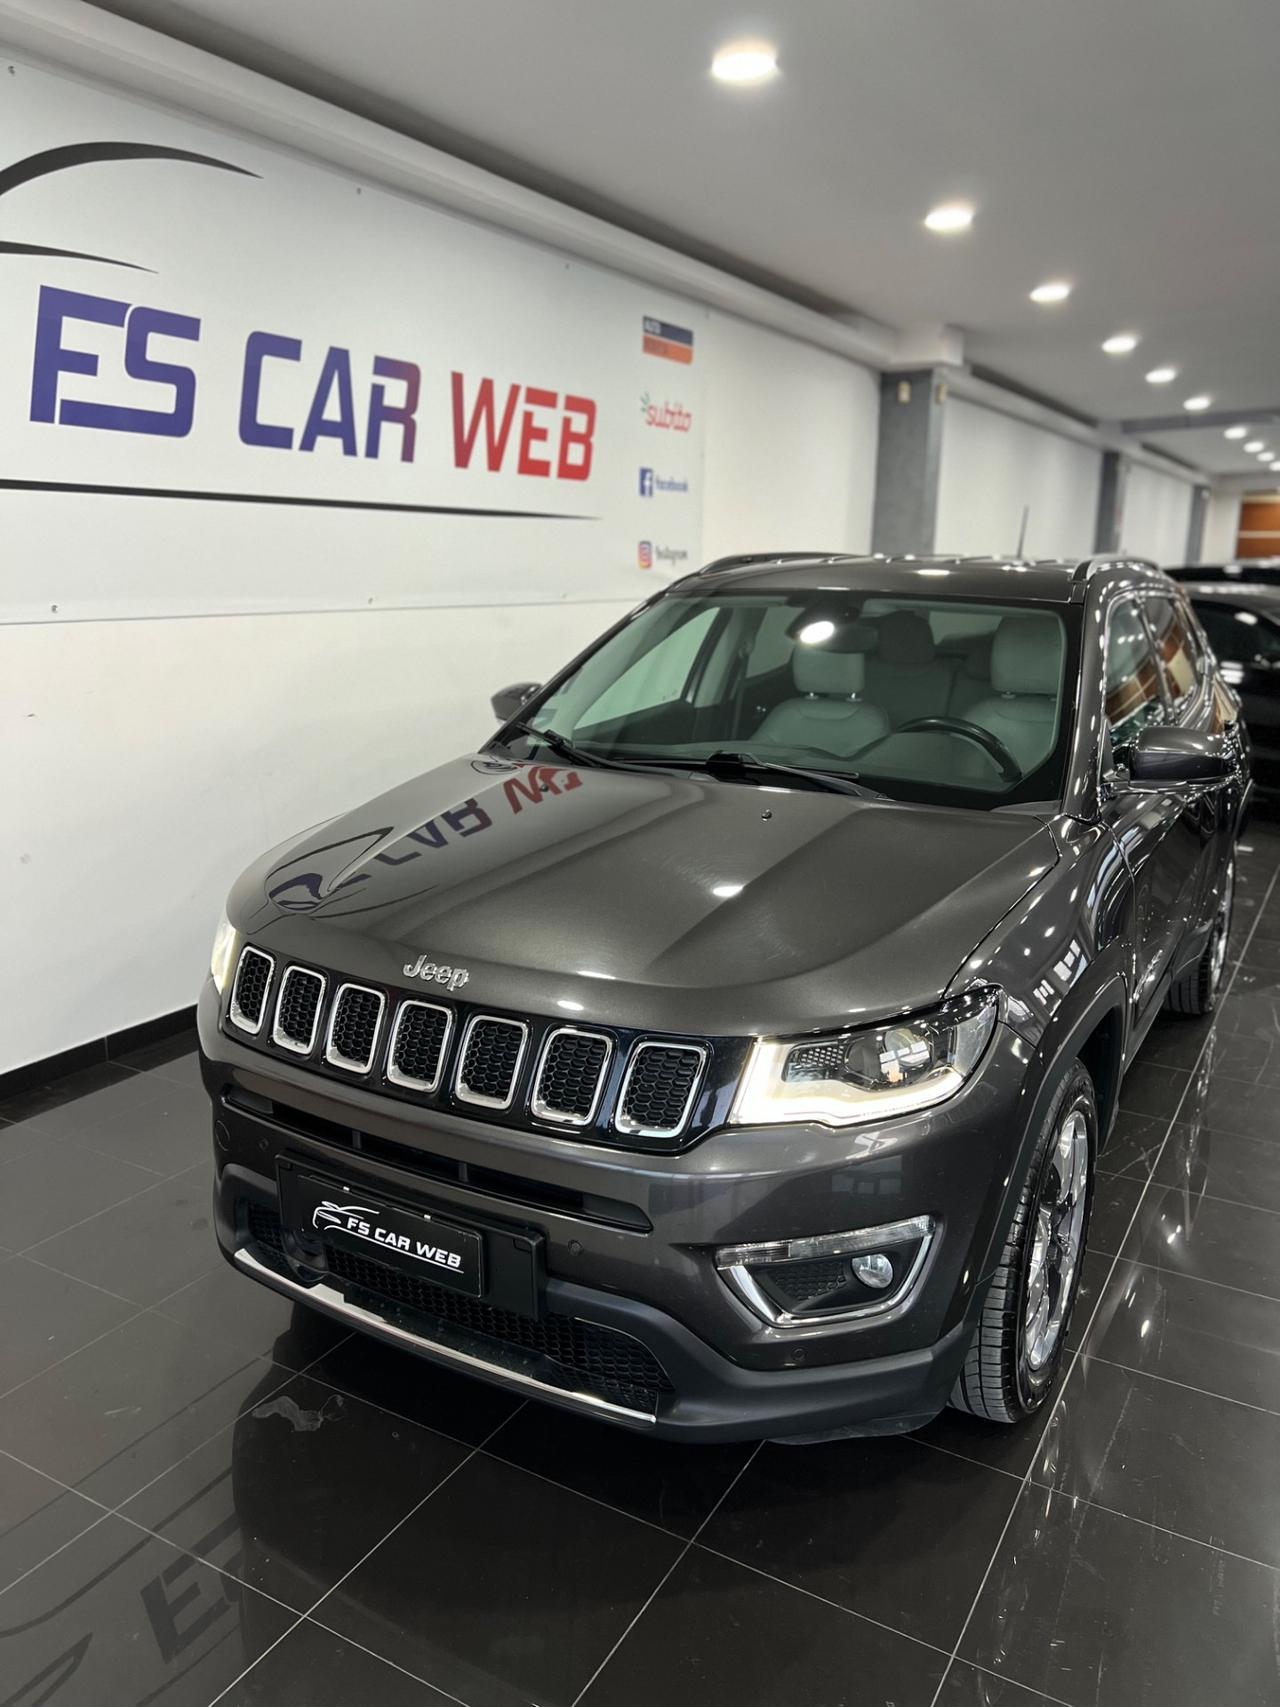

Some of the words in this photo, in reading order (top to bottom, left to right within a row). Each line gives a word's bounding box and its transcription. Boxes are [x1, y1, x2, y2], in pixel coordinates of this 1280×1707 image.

[238, 331, 421, 463] CAR
[451, 371, 597, 481] WEB
[403, 955, 469, 991] Jeep
[347, 1217, 371, 1235] FS
[374, 1227, 411, 1250] CAR
[416, 1241, 462, 1268] WEB
